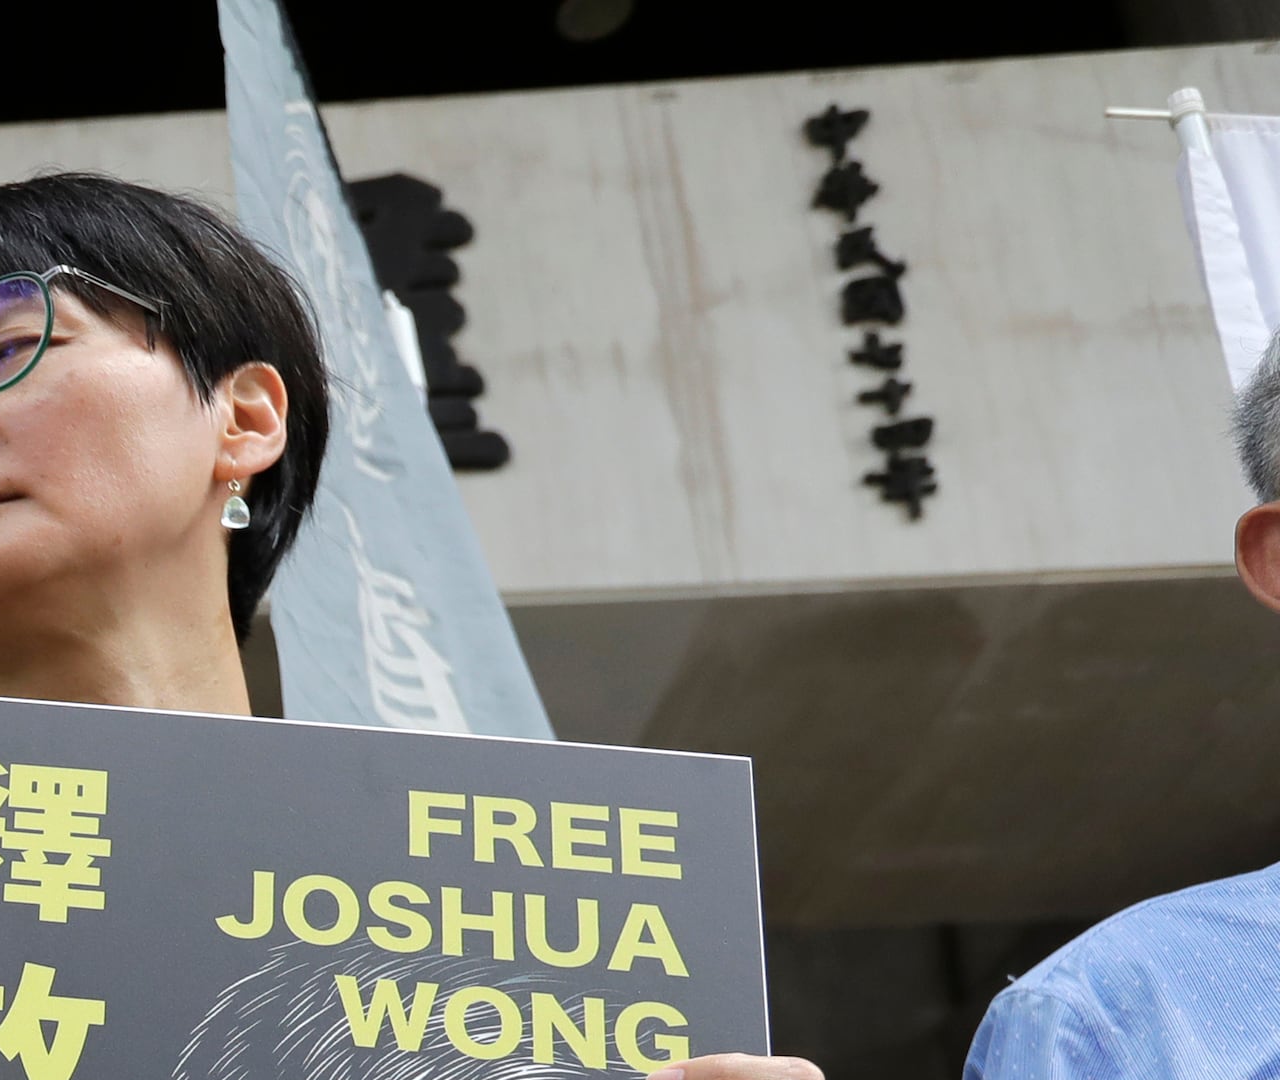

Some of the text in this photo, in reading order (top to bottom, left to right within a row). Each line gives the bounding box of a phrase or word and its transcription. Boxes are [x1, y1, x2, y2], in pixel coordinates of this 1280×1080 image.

[410, 791, 682, 878] FREE
[217, 872, 689, 977] JOSHUA
[336, 975, 692, 1073] WONG
